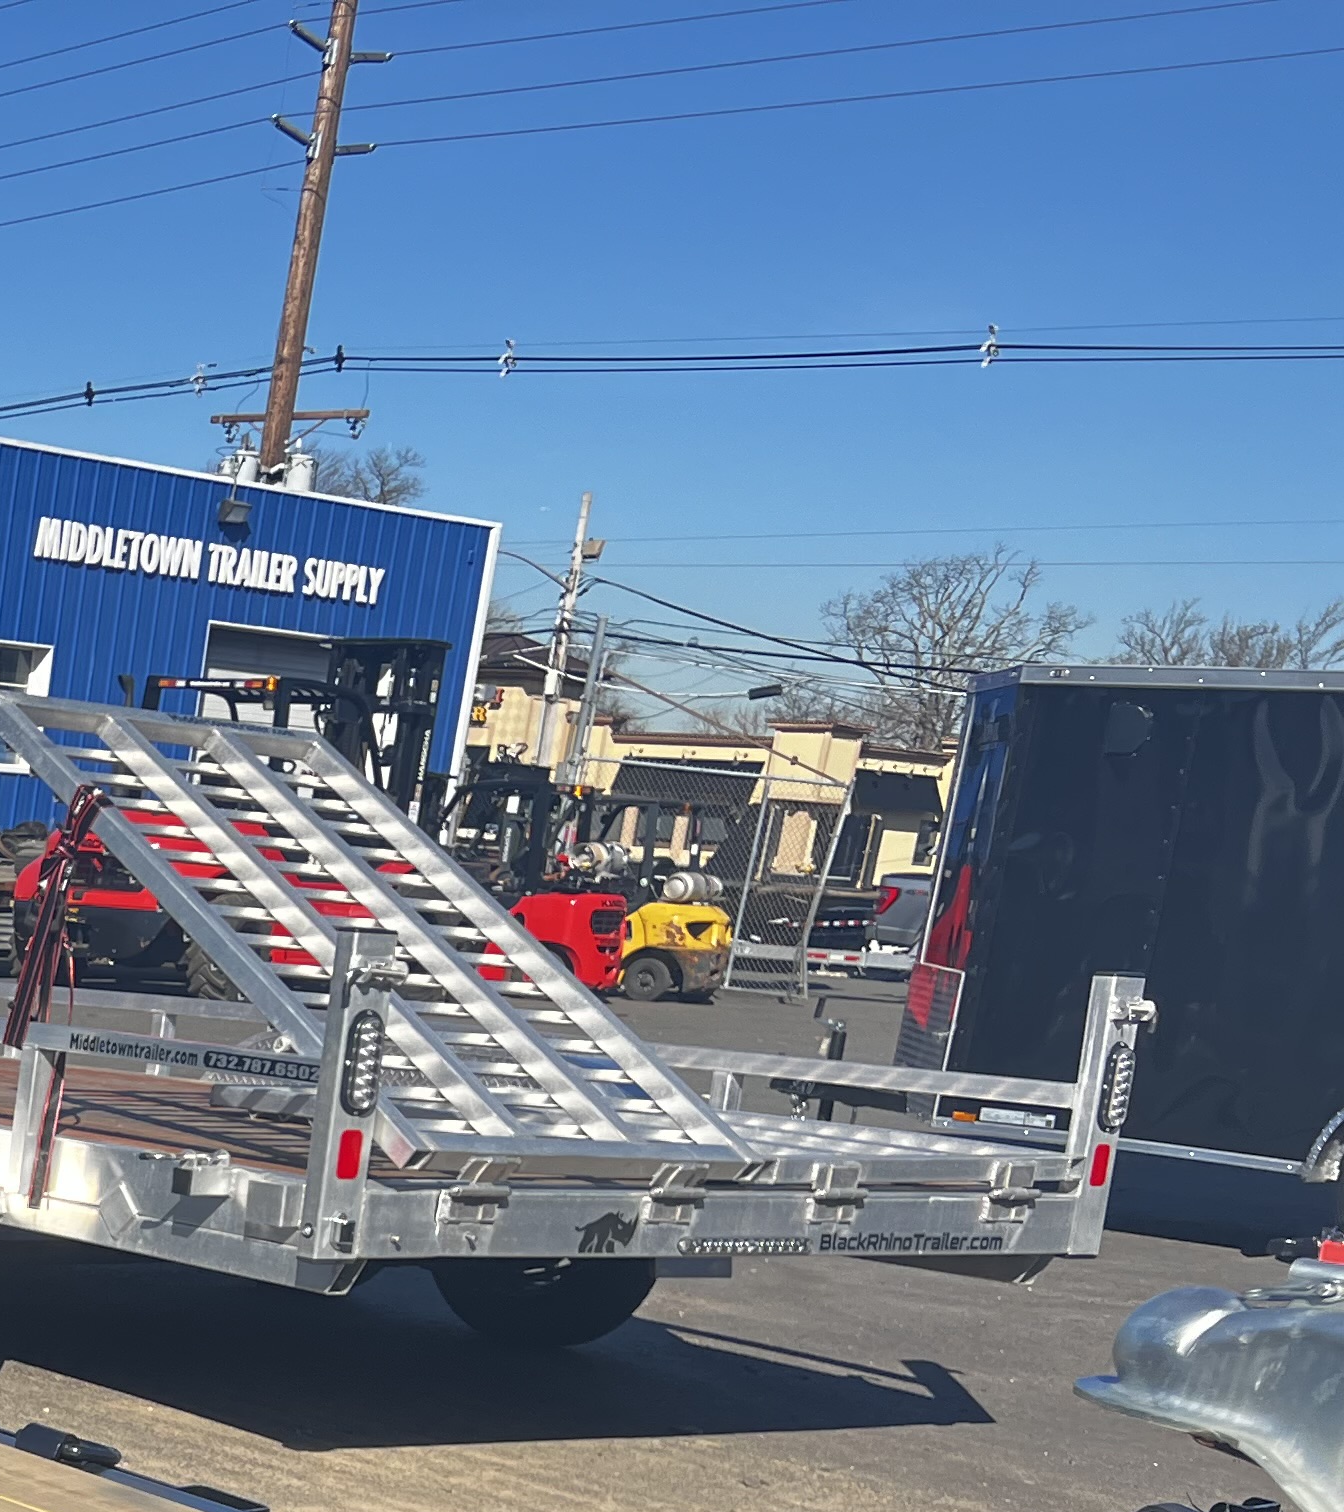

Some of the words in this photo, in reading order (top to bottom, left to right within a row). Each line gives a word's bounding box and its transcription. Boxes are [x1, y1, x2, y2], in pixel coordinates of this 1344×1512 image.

[33, 516, 203, 580] MIDDLETOWN
[208, 543, 298, 594] TRAILER
[302, 557, 386, 606] SUPPLY
[69, 1032, 198, 1067] Middletowntrailer.com
[819, 1232, 1004, 1251] BlackRhinoTrailer.com
